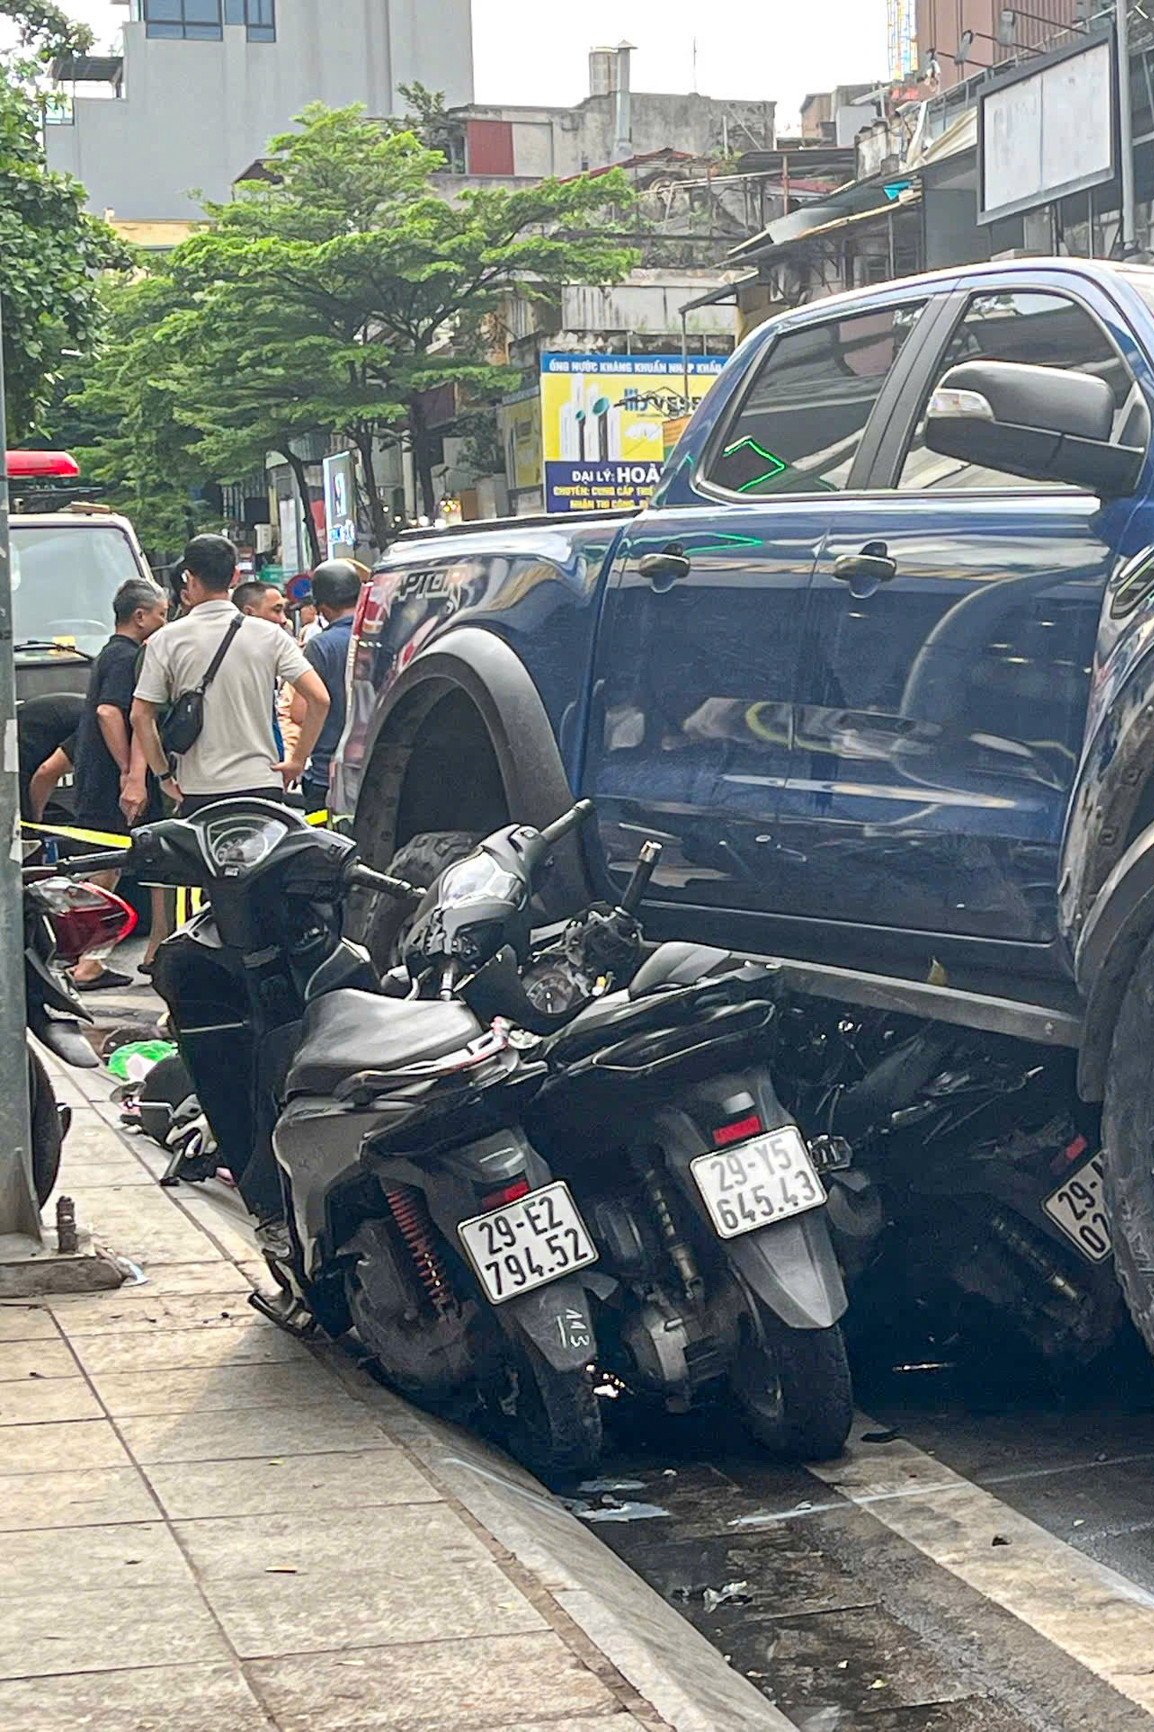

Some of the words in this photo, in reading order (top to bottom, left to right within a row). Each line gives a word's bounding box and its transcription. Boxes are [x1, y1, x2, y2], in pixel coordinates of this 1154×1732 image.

[572, 471, 594, 484] ĐẠI
[710, 1139, 792, 1192] 29-Y5
[478, 1196, 564, 1256] 29-E2
[716, 1170, 816, 1229] 645.43
[485, 1227, 588, 1295] 794.52
